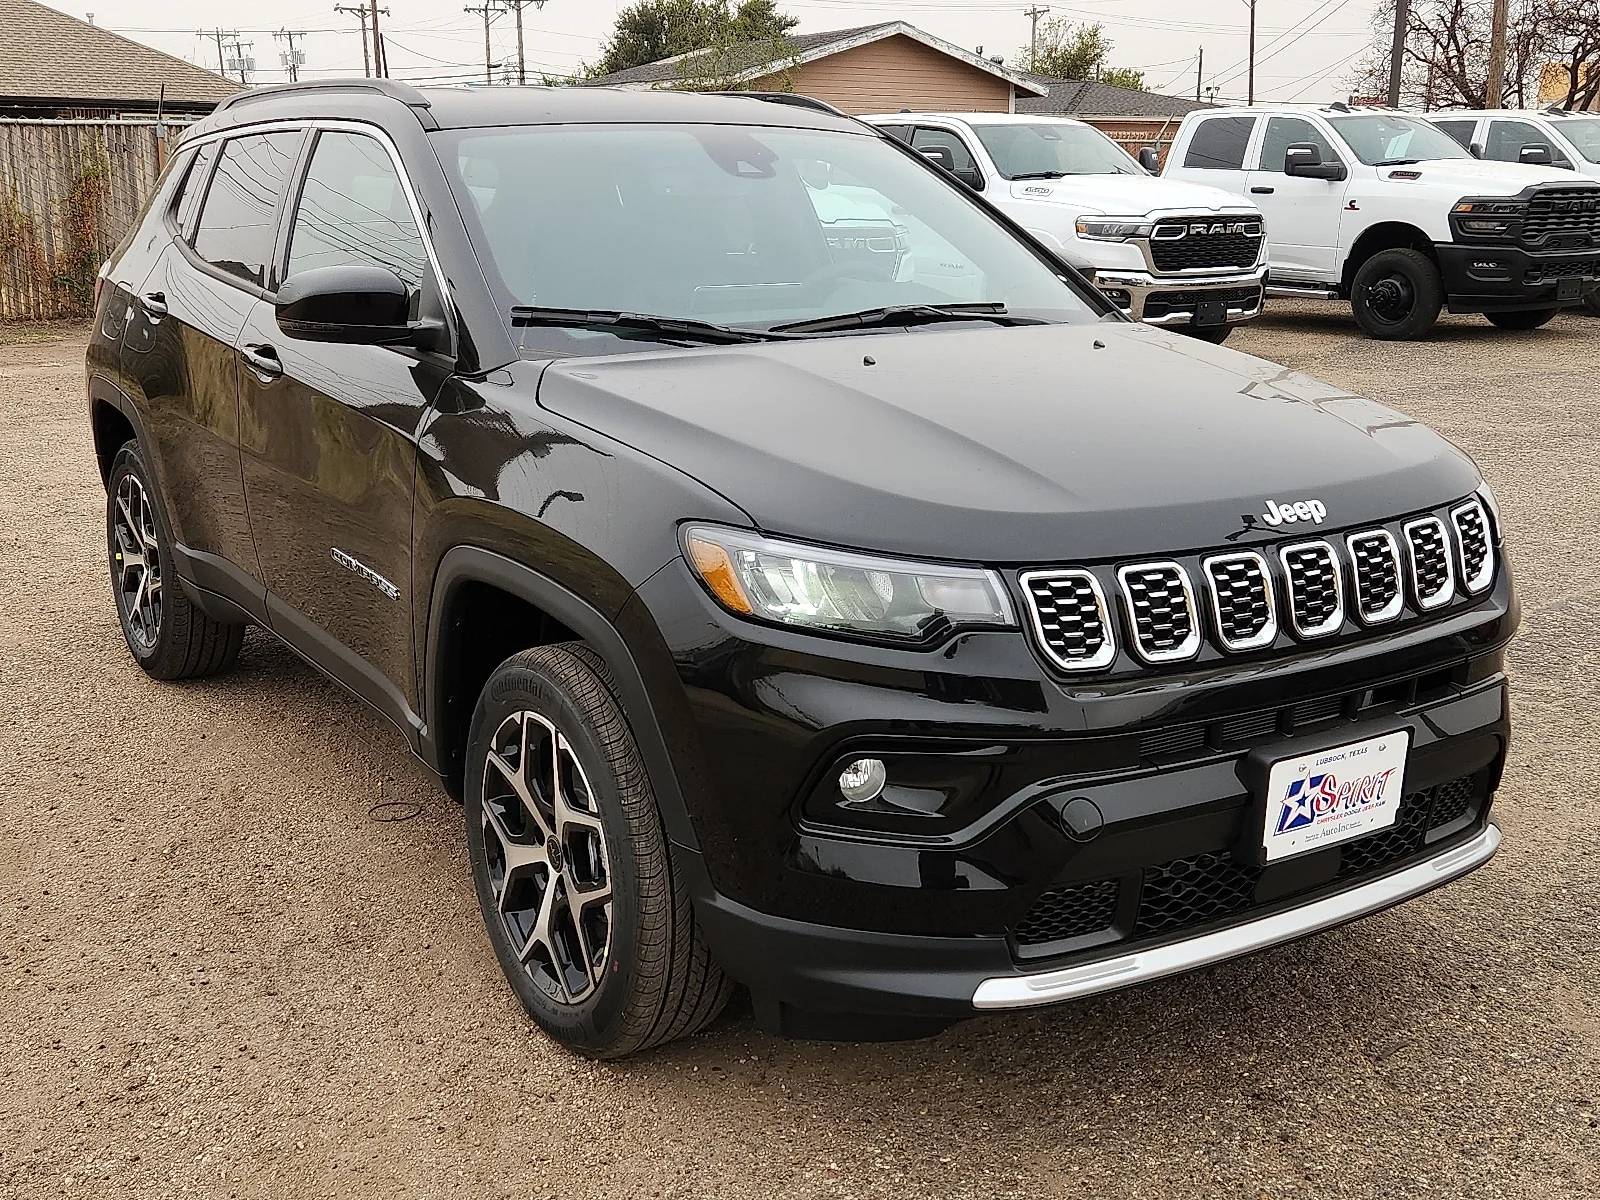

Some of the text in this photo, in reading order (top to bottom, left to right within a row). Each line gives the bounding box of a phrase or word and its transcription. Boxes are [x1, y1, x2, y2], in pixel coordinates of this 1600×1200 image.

[1553, 200, 1596, 211] RAM
[1190, 223, 1244, 234] RAM
[1261, 499, 1327, 527] Jeep
[1316, 747, 1368, 766] LUBBOCK, TEXAS
[1316, 814, 1343, 825] CHRYSLER
[1344, 808, 1362, 818] DODGE
[1362, 804, 1375, 812] JEEP
[1375, 800, 1387, 809] RAM
